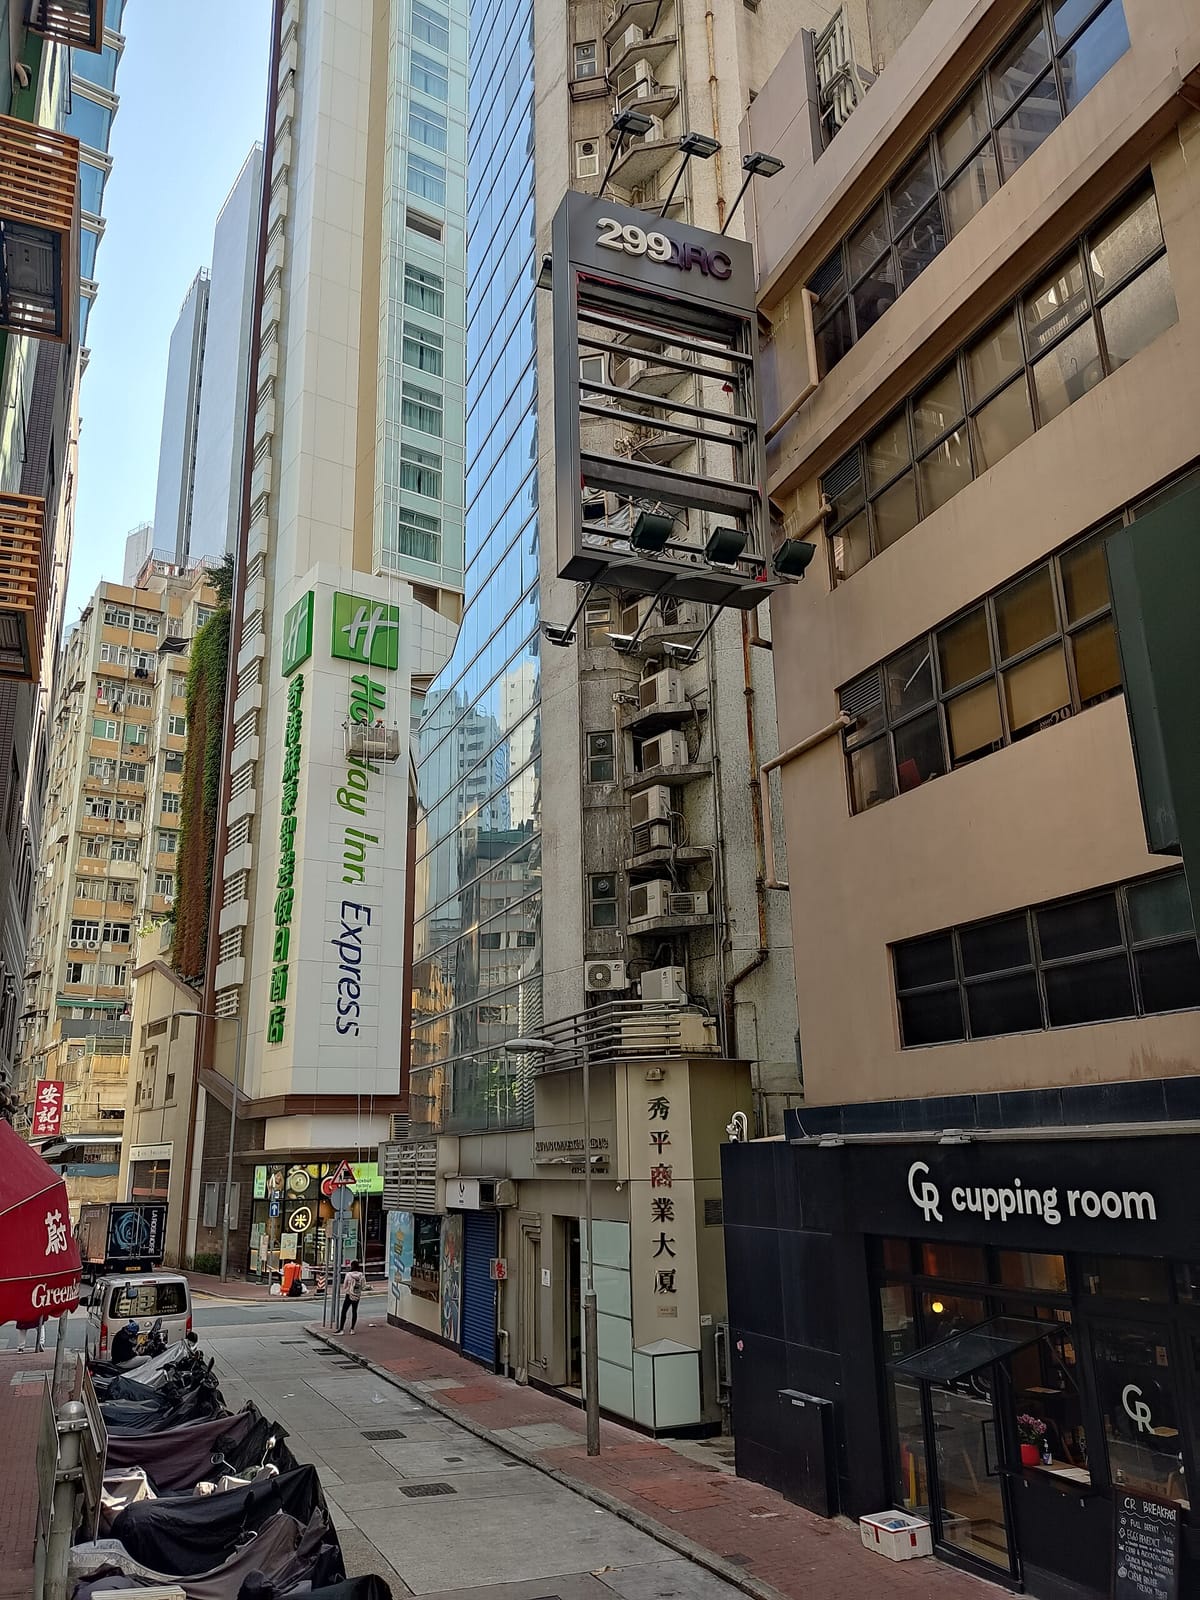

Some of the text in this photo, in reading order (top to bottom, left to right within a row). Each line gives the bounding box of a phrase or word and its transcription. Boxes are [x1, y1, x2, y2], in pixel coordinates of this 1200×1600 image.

[331, 900, 372, 1037] Express
[36, 1083, 61, 1123] 安記
[951, 1177, 1061, 1225] cupping
[1067, 1190, 1157, 1221] room
[45, 1208, 68, 1256] 蔚
[1124, 1497, 1177, 1521] CR BREAKFAST
